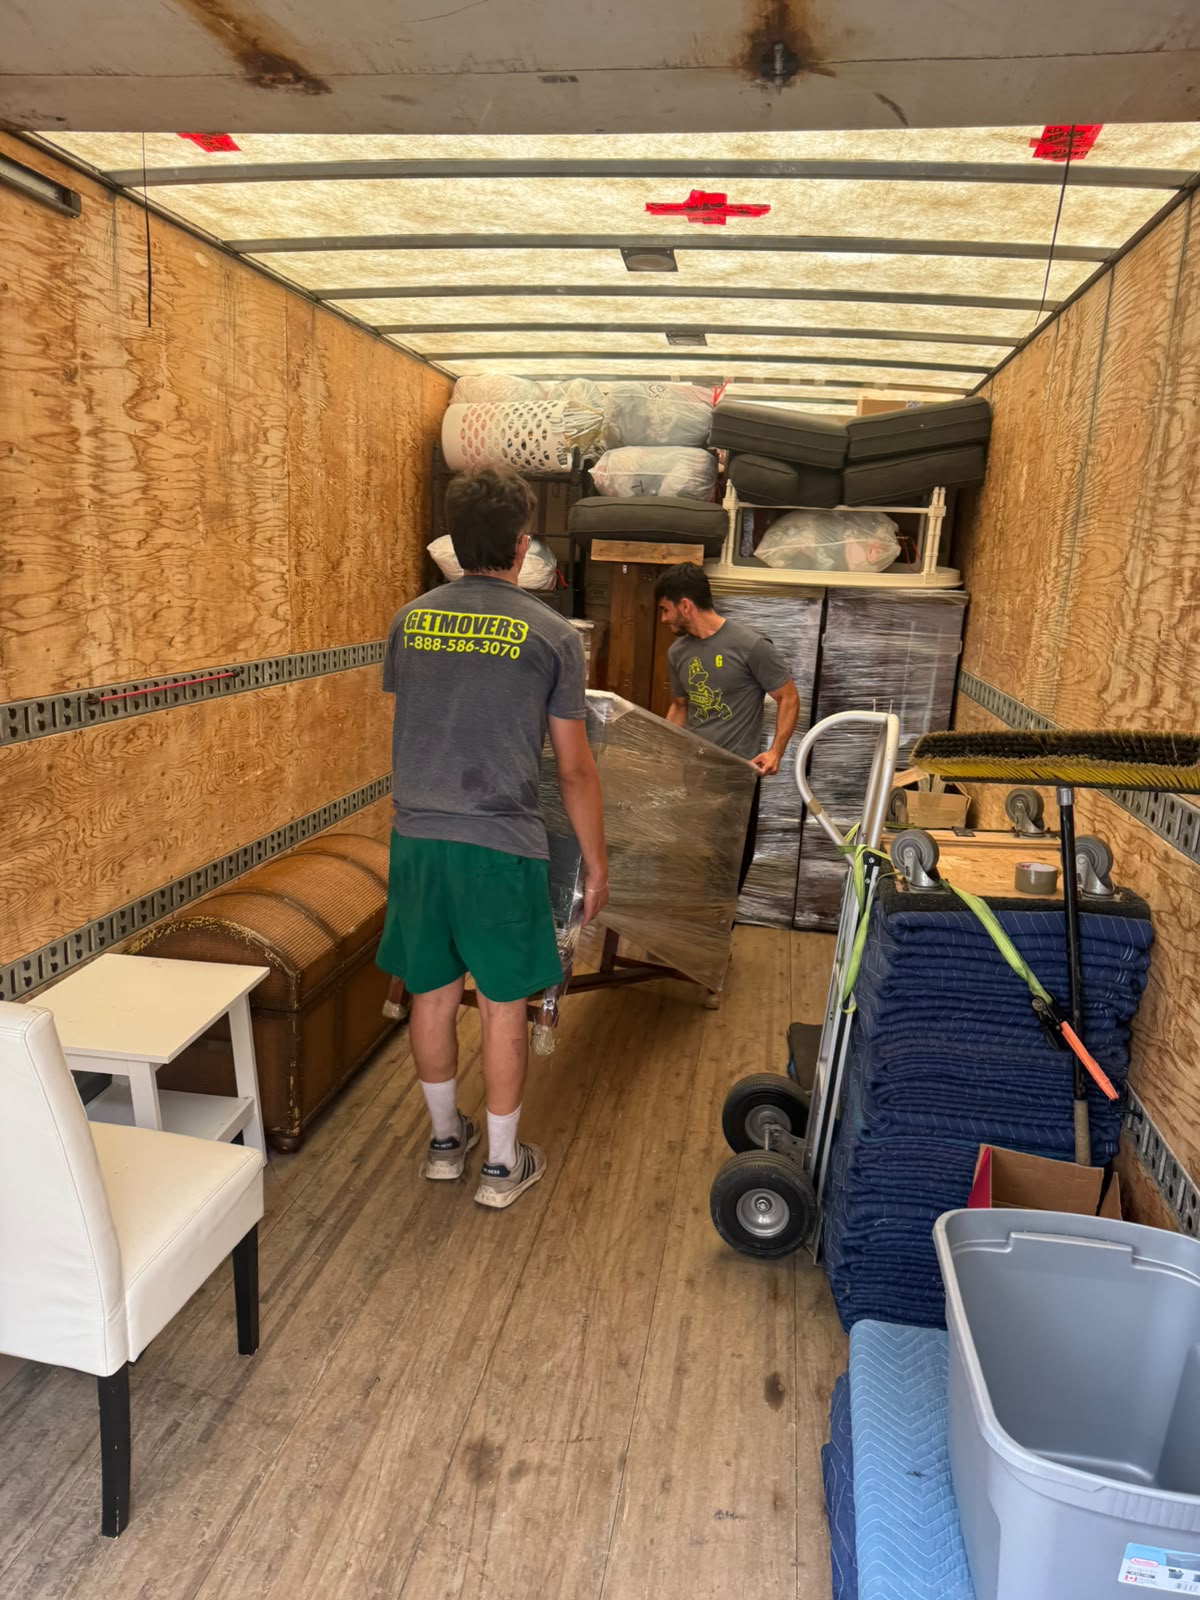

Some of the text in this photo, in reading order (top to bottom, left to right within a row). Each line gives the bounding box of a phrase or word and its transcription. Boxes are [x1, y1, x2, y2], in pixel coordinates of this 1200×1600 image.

[404, 609, 528, 643] GETMOVERS
[404, 636, 520, 659] 1-888-586-3070
[715, 654, 723, 668] G
